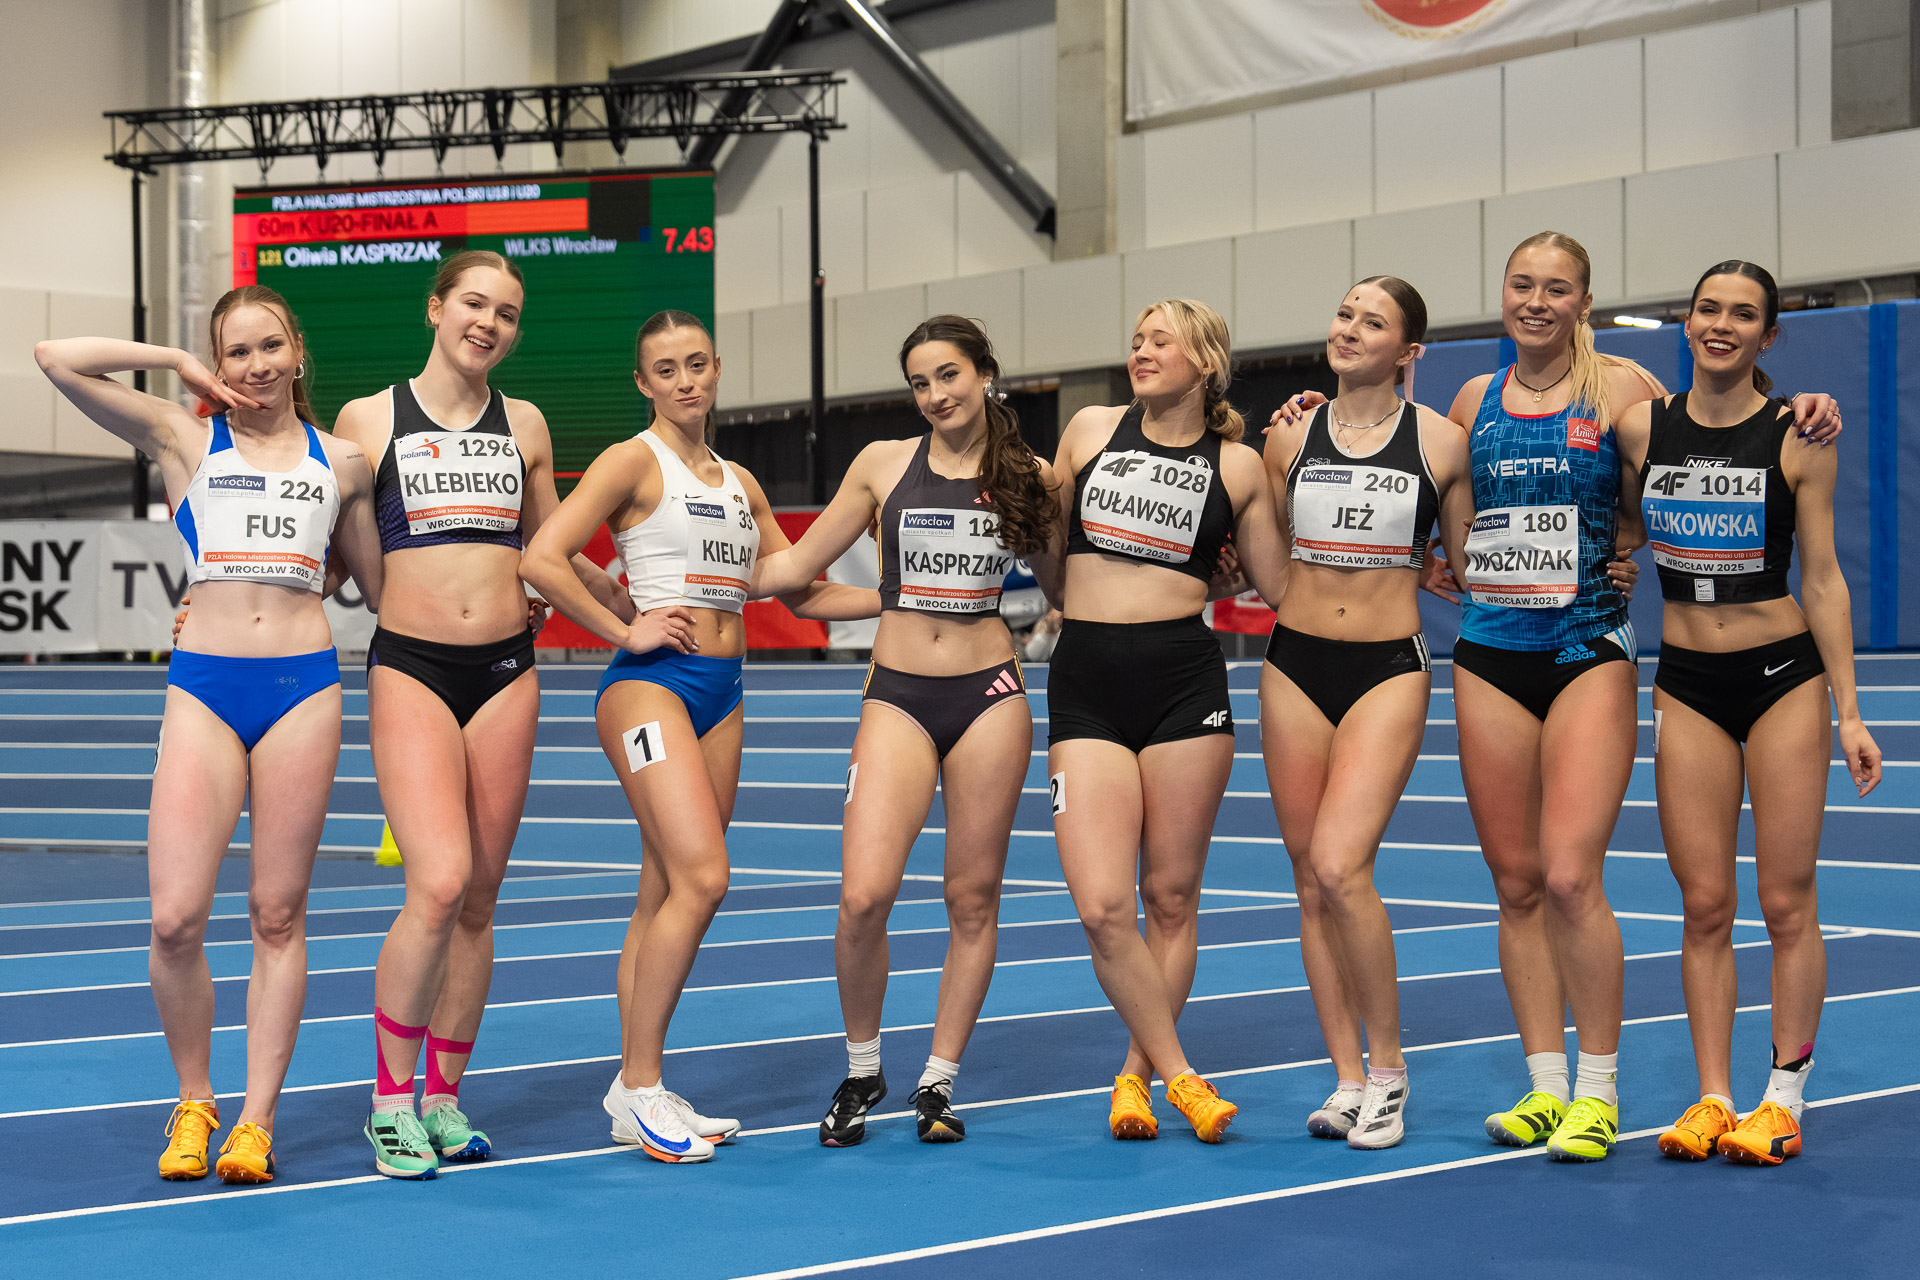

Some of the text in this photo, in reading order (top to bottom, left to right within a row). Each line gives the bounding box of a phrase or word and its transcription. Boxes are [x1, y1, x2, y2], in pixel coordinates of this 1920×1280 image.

[258, 210, 438, 236] 60m K U20-FINAŁ A
[283, 246, 338, 268] Oliwia
[340, 241, 442, 265] KASPRZAK
[504, 237, 551, 256] WLKS
[552, 235, 617, 255] Wrocław
[662, 226, 714, 253] 7.43
[1571, 425, 1598, 440] Anwil
[400, 438, 515, 460] polanik 1296
[1487, 457, 1571, 478] VECTRA
[1686, 459, 1726, 468] NIKE
[404, 472, 519, 497] KLEBIEKO
[1101, 457, 1207, 493] 4F 1028
[1305, 471, 1408, 494] Wrocław 240
[1651, 471, 1762, 496] 4F 1014
[213, 477, 324, 504] Wrocław 224
[688, 504, 723, 516] Wrocław
[1086, 486, 1193, 532] PUŁAWSKA
[1332, 503, 1374, 531] JEŻ
[1647, 503, 1759, 537] ŻUKOWSKA
[247, 515, 296, 539] FUS
[427, 518, 505, 530] WROCŁAW 2025
[907, 515, 951, 527] Wrocław
[1474, 512, 1567, 532] Wrocław 180
[1091, 535, 1171, 560] WROCŁAW 2025
[1092, 525, 1112, 534] Halowe
[1112, 529, 1146, 542] Mistrzostwa
[1147, 538, 1163, 546] Polski
[1163, 541, 1174, 549] U18
[1330, 544, 1364, 552] Mistrzostwa
[703, 539, 752, 570] KIELAR
[904, 551, 1010, 576] KASPRZAK
[1310, 552, 1392, 565] WROCŁAW 2025
[1471, 547, 1573, 572] WOŹNIAK
[1665, 556, 1744, 572] WROCŁAW 2025
[1680, 551, 1713, 559] Mistrzostwa
[224, 565, 309, 578] WROCŁAW 2025
[916, 598, 987, 610] WROCŁAW 2025
[1485, 595, 1559, 605] WROCŁAW 2025
[1555, 649, 1597, 664] adidas
[1202, 709, 1227, 728] 4F
[633, 727, 652, 763] 1
